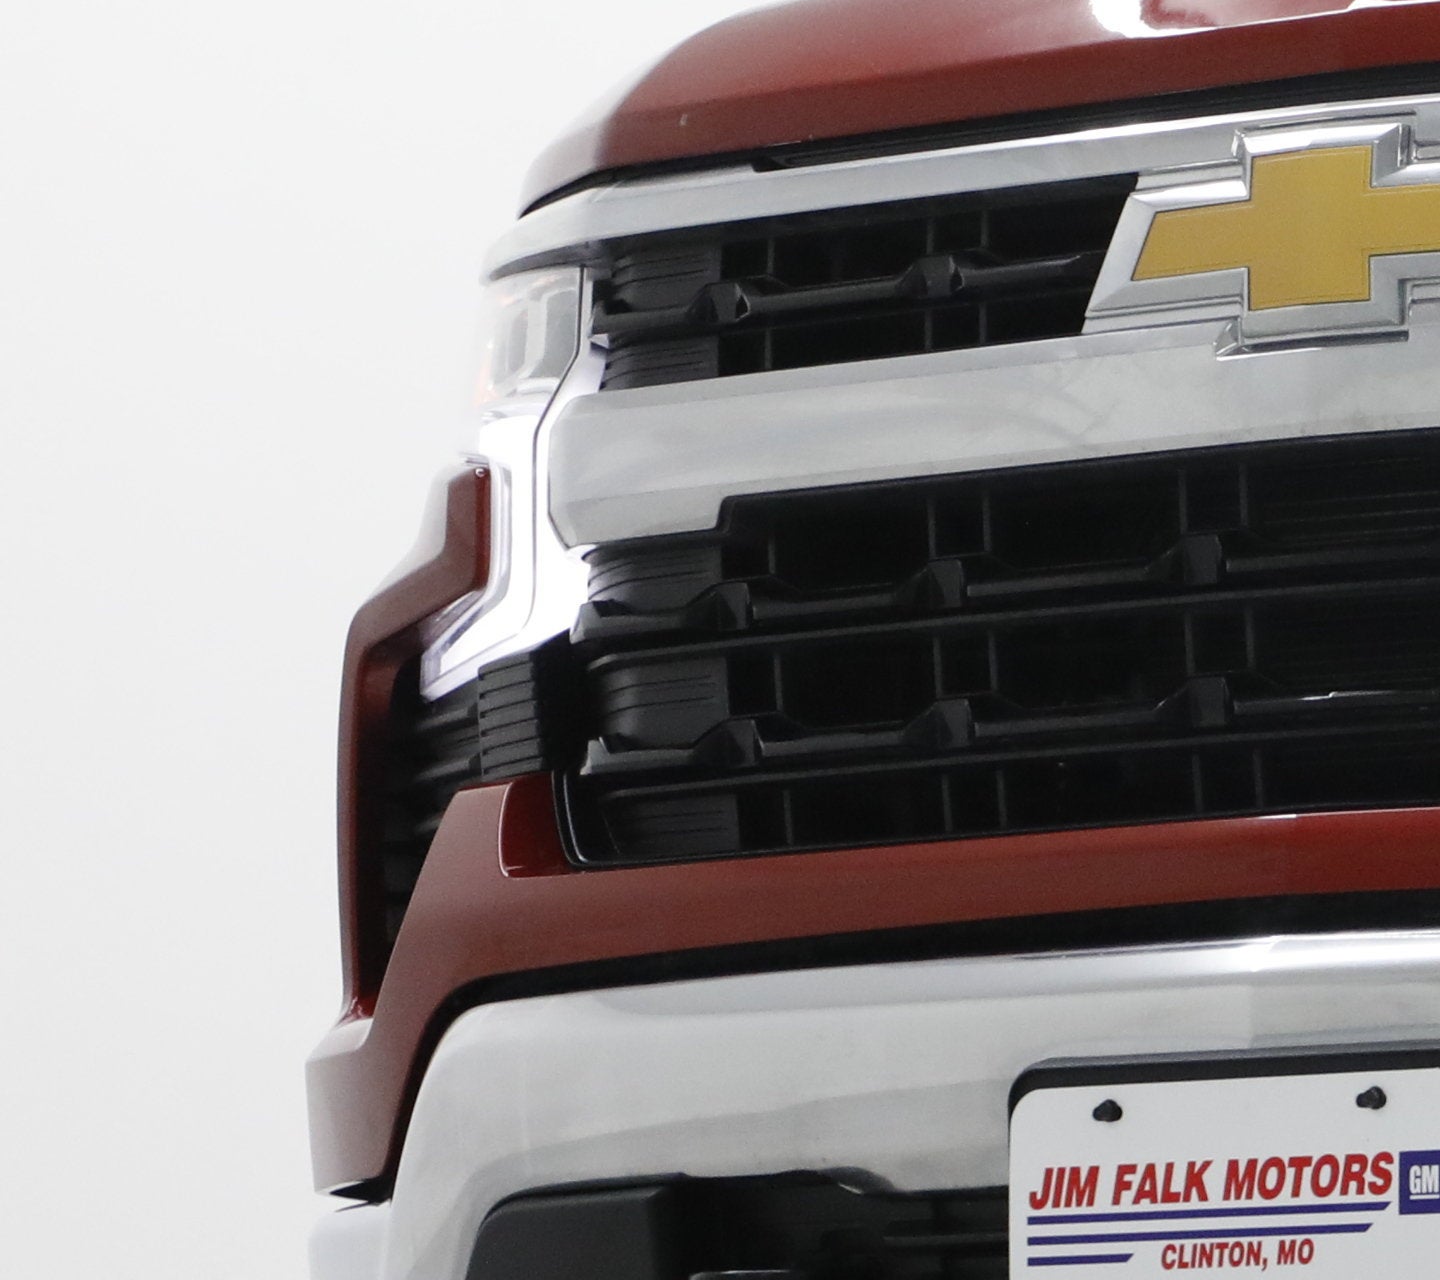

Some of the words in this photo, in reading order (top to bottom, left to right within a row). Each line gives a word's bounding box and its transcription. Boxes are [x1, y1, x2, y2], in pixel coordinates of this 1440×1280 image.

[1028, 1166, 1100, 1211] JIM
[1112, 1160, 1212, 1206] FALK
[1223, 1151, 1395, 1201] MOTORS
[1409, 1164, 1440, 1194] GM
[1161, 1241, 1268, 1272] CLINTON,
[1276, 1238, 1315, 1265] MO
